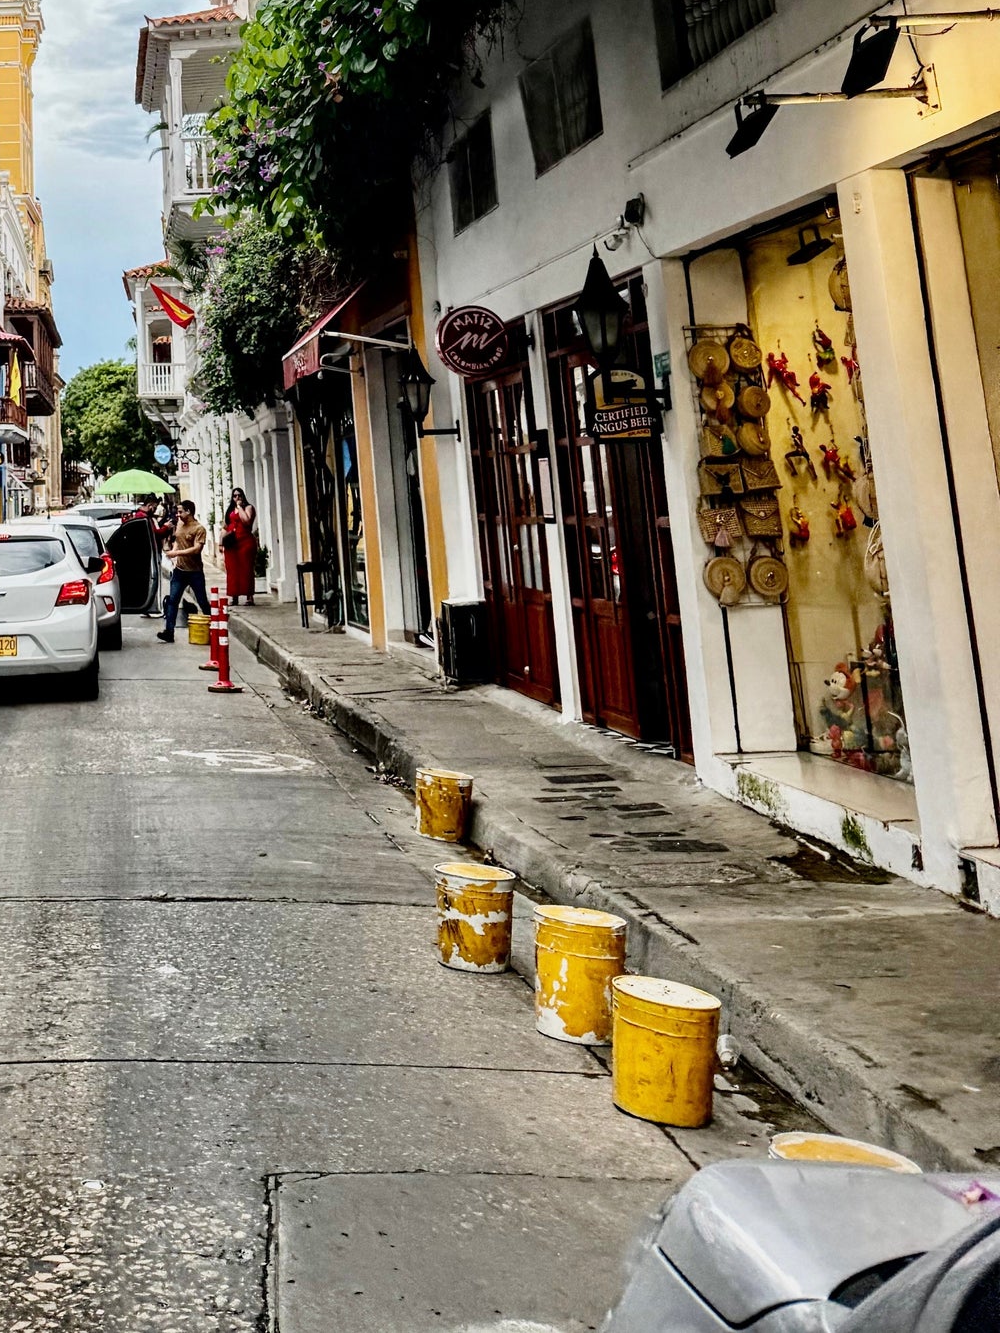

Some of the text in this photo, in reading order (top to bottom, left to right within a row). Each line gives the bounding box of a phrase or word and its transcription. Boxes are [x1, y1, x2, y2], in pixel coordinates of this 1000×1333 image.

[450, 347, 503, 370] COLOMBIAN FOOD
[594, 406, 648, 422] CERTIFIED
[592, 420, 629, 433] ANGUS
